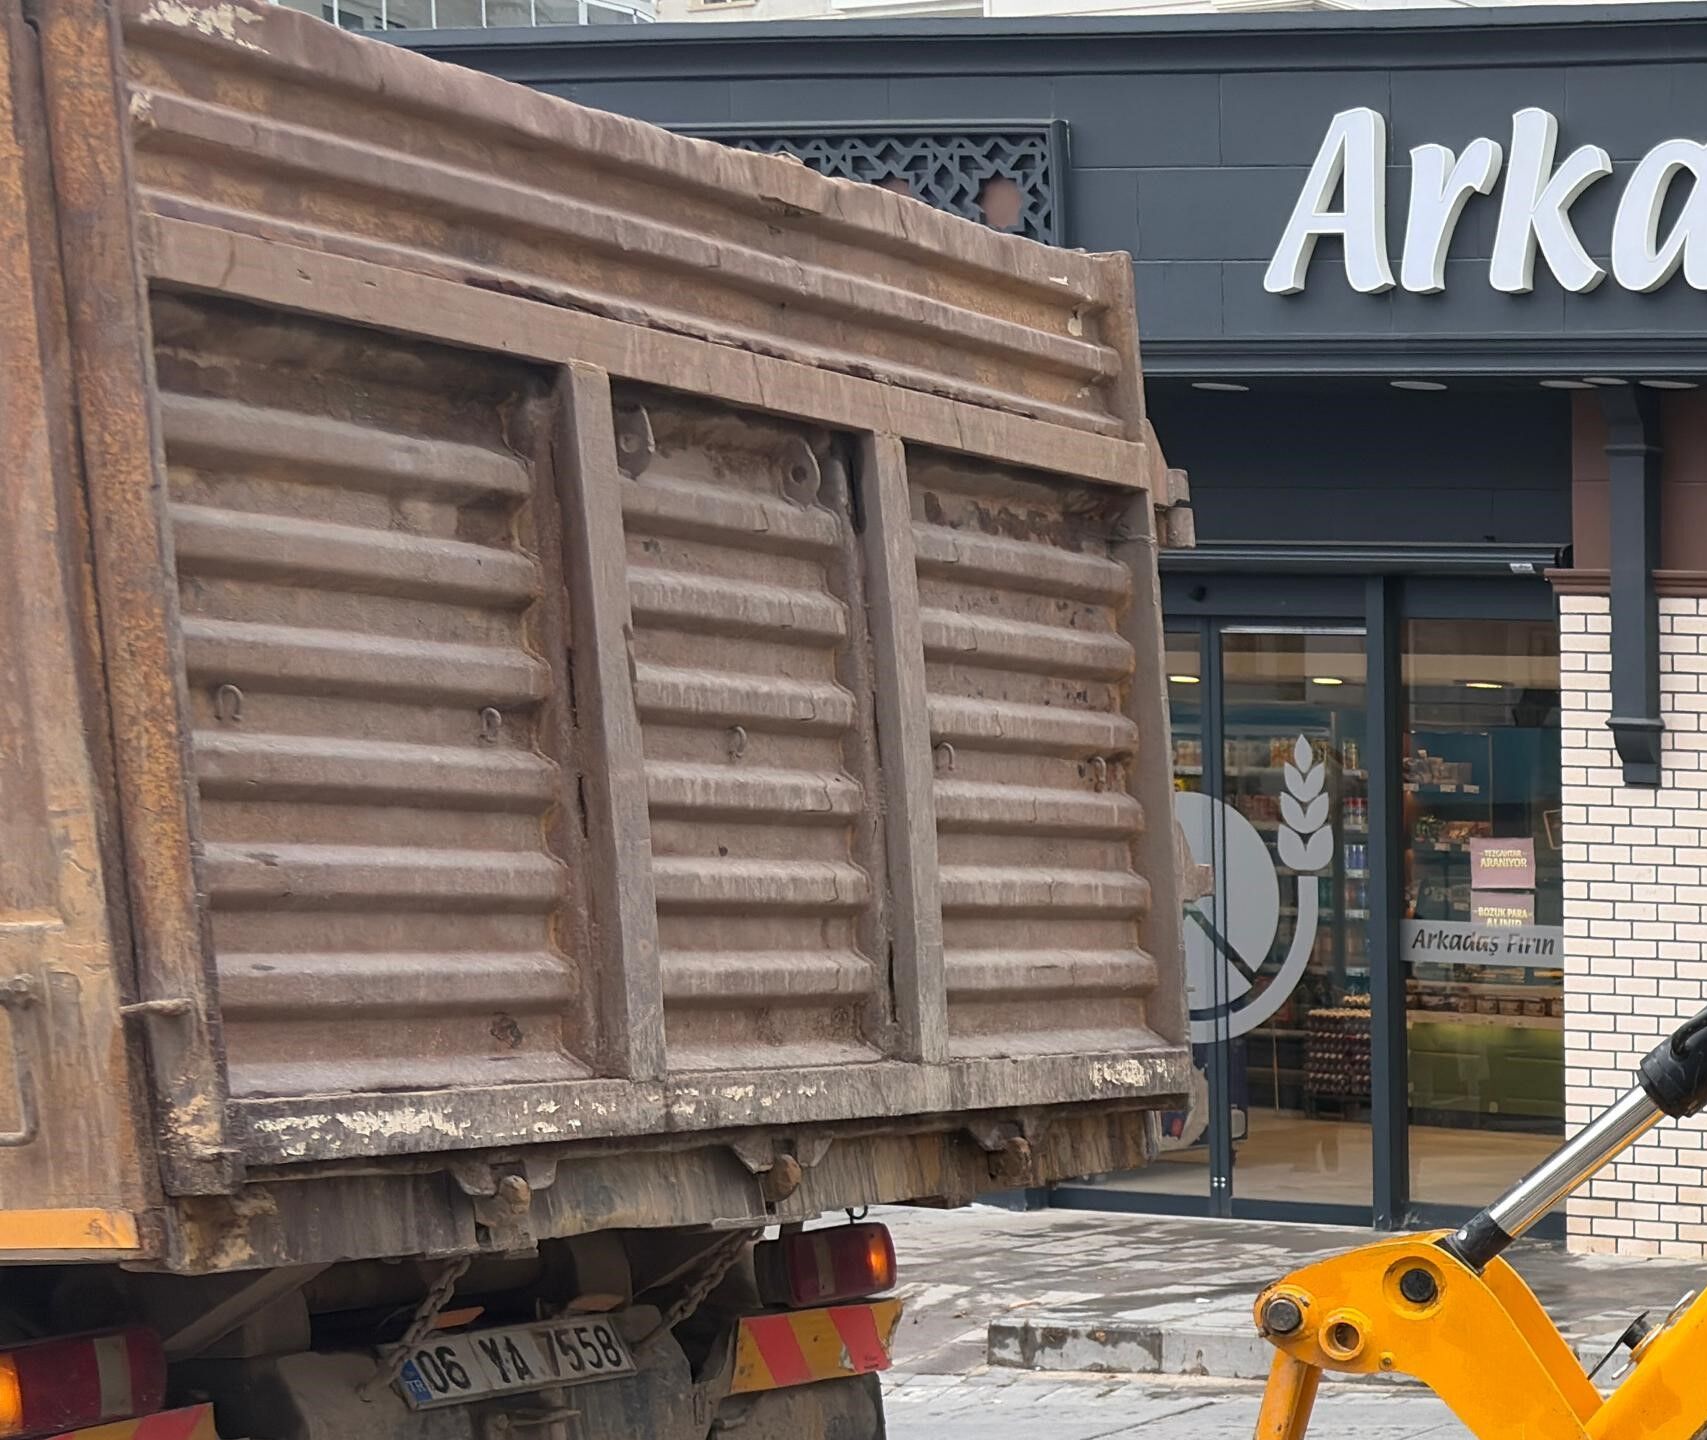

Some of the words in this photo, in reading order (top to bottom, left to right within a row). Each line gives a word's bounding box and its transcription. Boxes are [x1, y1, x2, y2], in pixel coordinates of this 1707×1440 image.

[1412, 928, 1499, 956] Arkadaş
[1507, 932, 1556, 956] Fırın
[415, 1345, 472, 1395] 06
[478, 1336, 536, 1384] YA
[535, 1325, 623, 1378] 7558
[404, 1380, 426, 1393] TR
